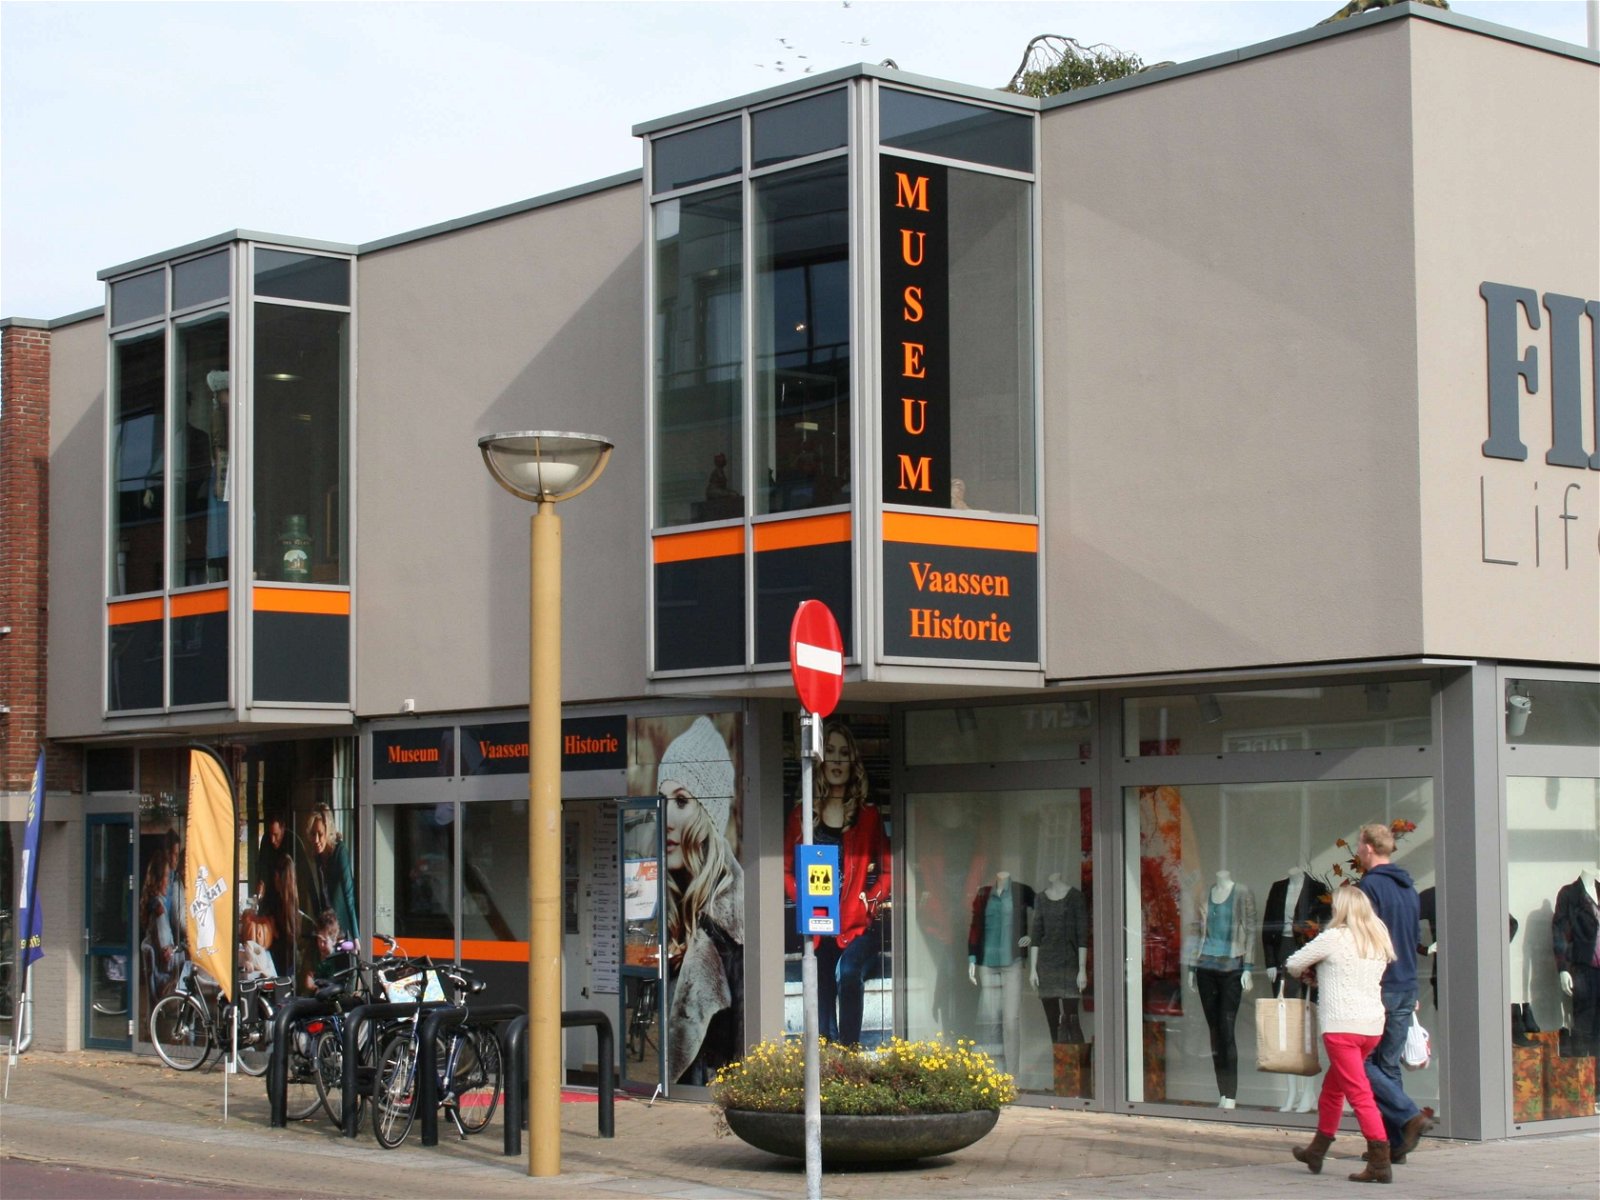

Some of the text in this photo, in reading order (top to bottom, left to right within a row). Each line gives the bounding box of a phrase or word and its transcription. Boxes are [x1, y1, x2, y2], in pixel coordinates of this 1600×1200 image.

[895, 171, 933, 493] MUSEUM
[1479, 280, 1600, 471] FI
[1480, 475, 1600, 570] Lif
[908, 561, 1010, 598] Vaassen
[909, 608, 1012, 644] Historie
[388, 745, 439, 763] Museum
[480, 734, 618, 759] Vaassen Historie
